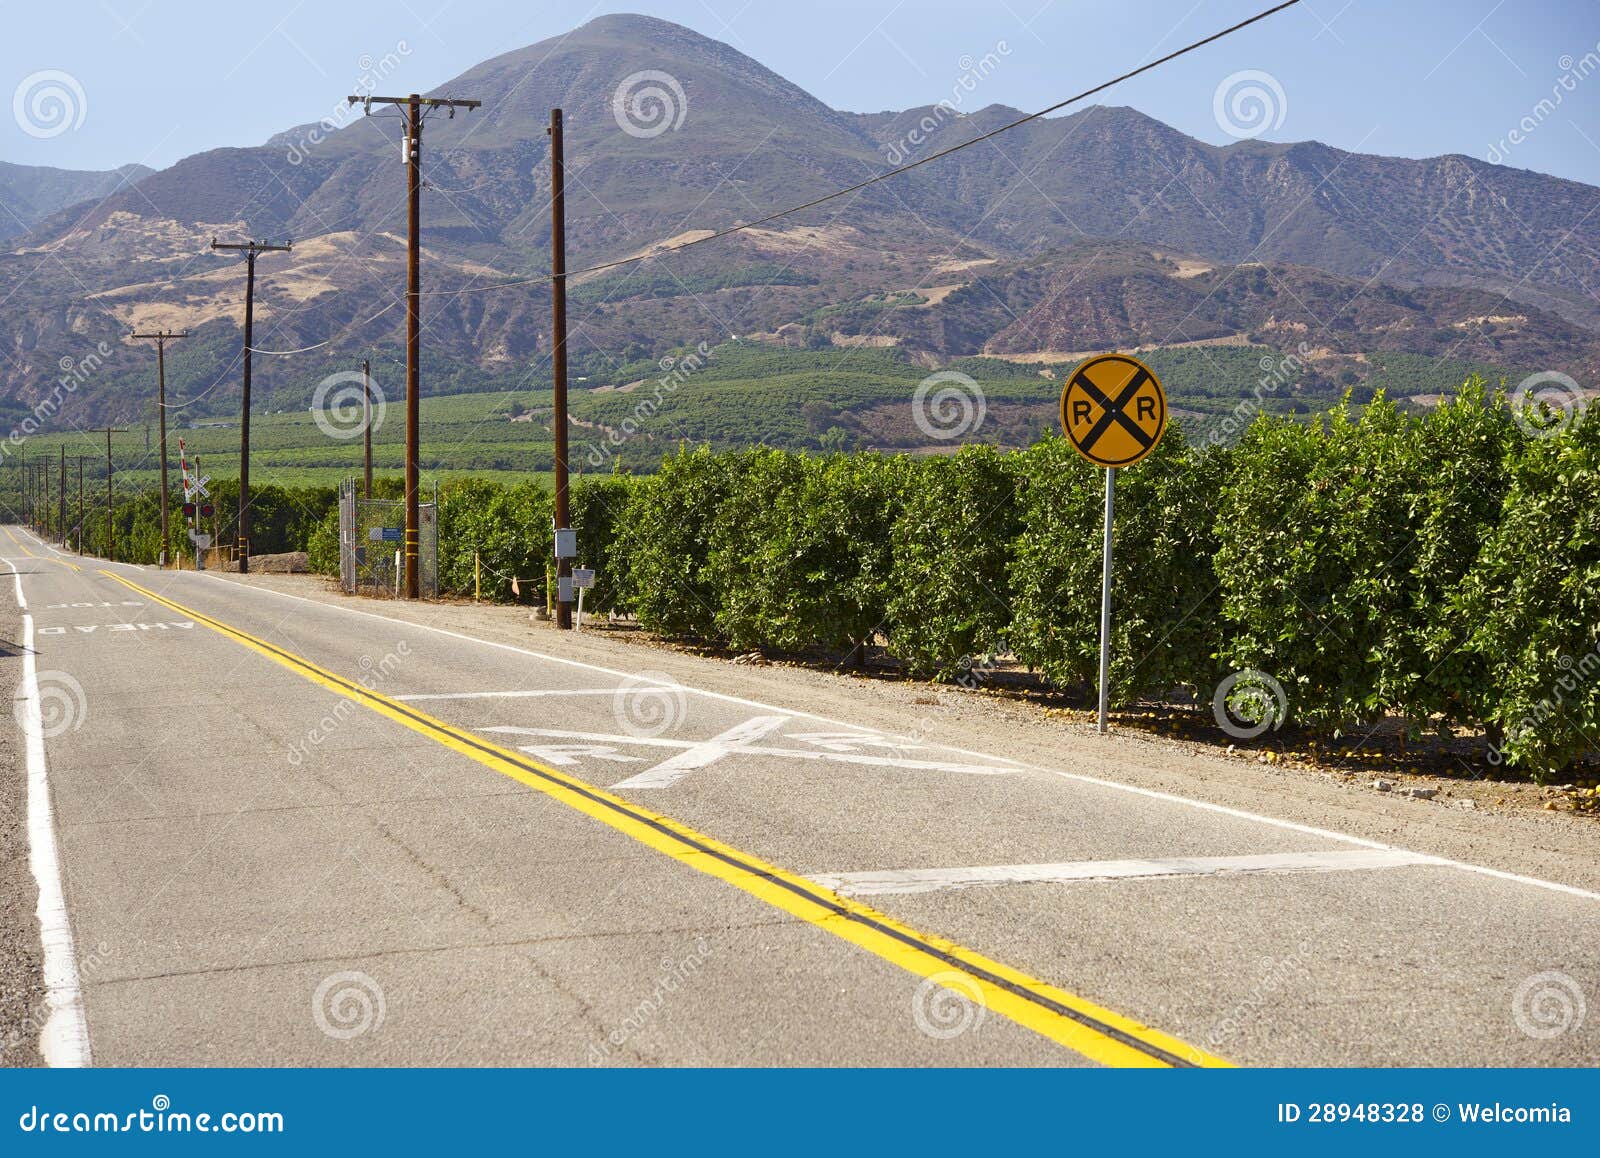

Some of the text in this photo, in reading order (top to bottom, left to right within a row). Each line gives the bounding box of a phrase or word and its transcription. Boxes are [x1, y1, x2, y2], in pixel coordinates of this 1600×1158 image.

[1073, 400, 1093, 426] R
[1136, 395, 1156, 422] R
[37, 621, 195, 635] AHEAD
